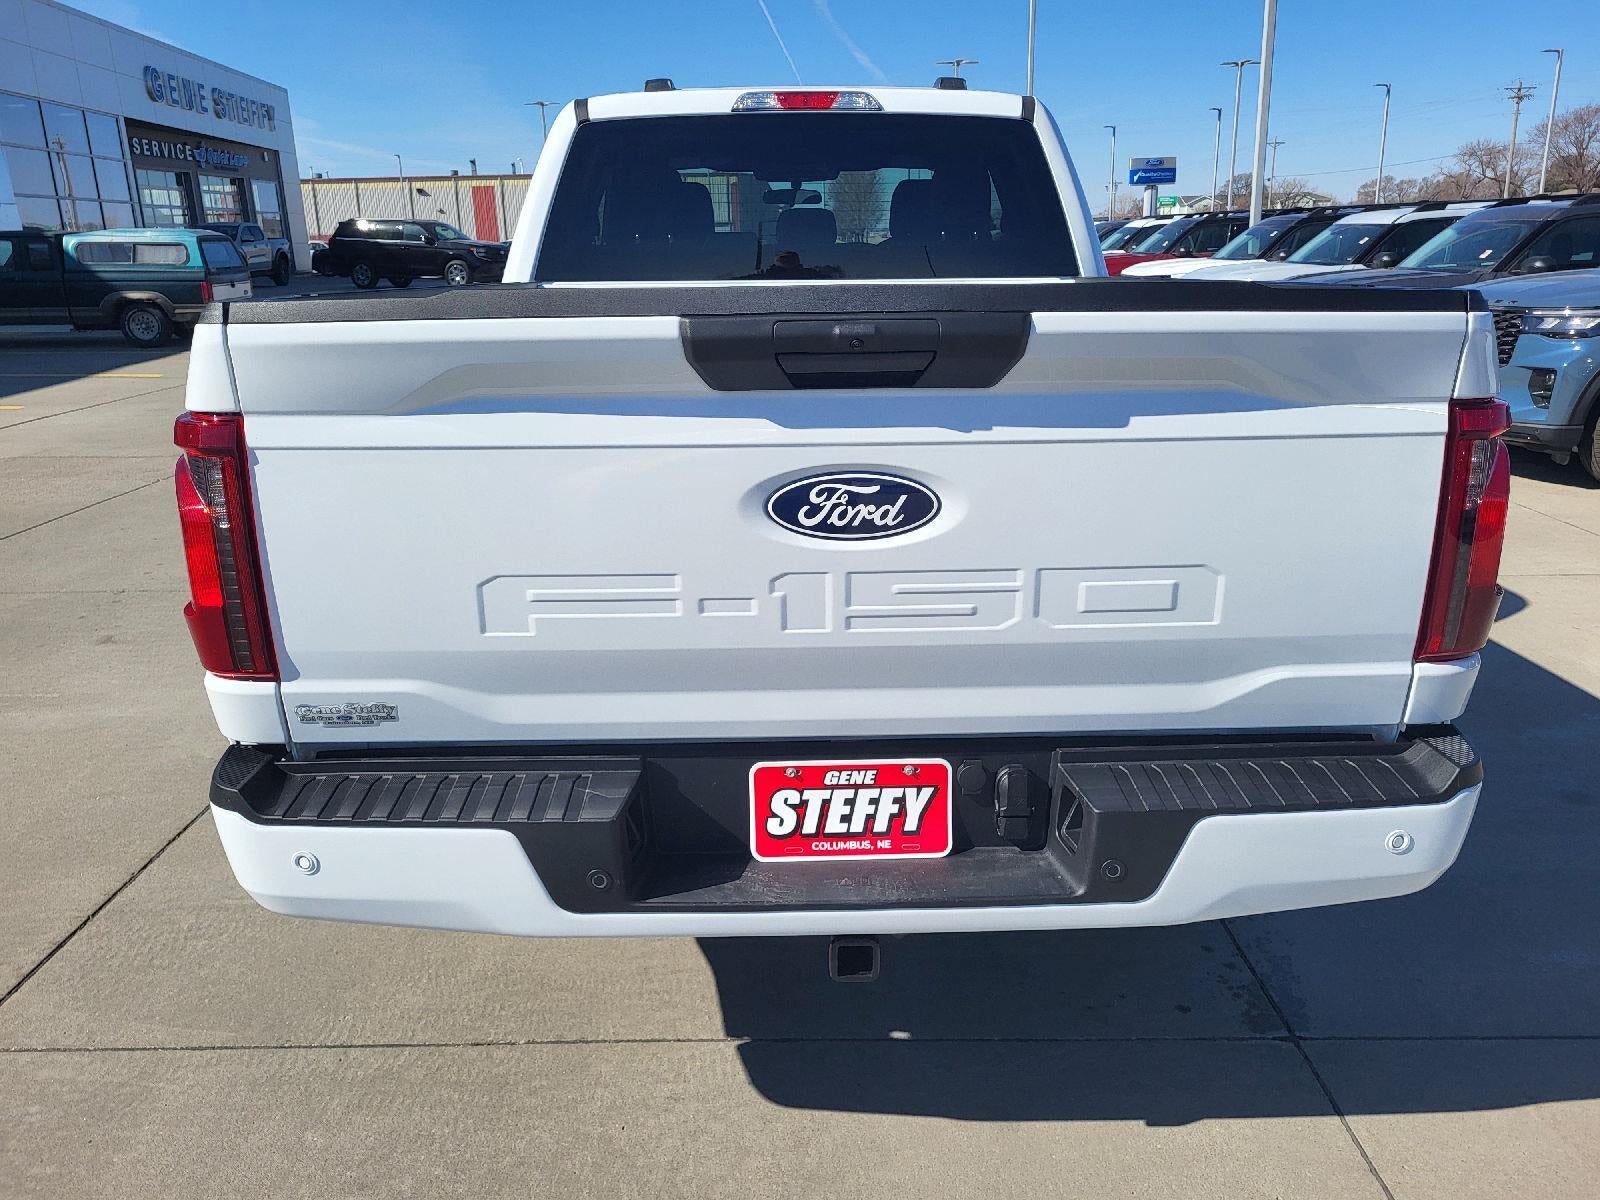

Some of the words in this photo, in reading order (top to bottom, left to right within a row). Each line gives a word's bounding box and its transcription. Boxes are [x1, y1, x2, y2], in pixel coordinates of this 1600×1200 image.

[143, 65, 209, 114] GENE
[212, 86, 277, 132] STEFFY
[132, 137, 194, 161] SERVICE
[797, 483, 908, 527] Ford
[476, 563, 1226, 637] F-150
[823, 770, 878, 786] GENE
[766, 787, 937, 837] STEFFY
[811, 839, 874, 851] COLUMBUS,
[877, 839, 892, 849] NE
